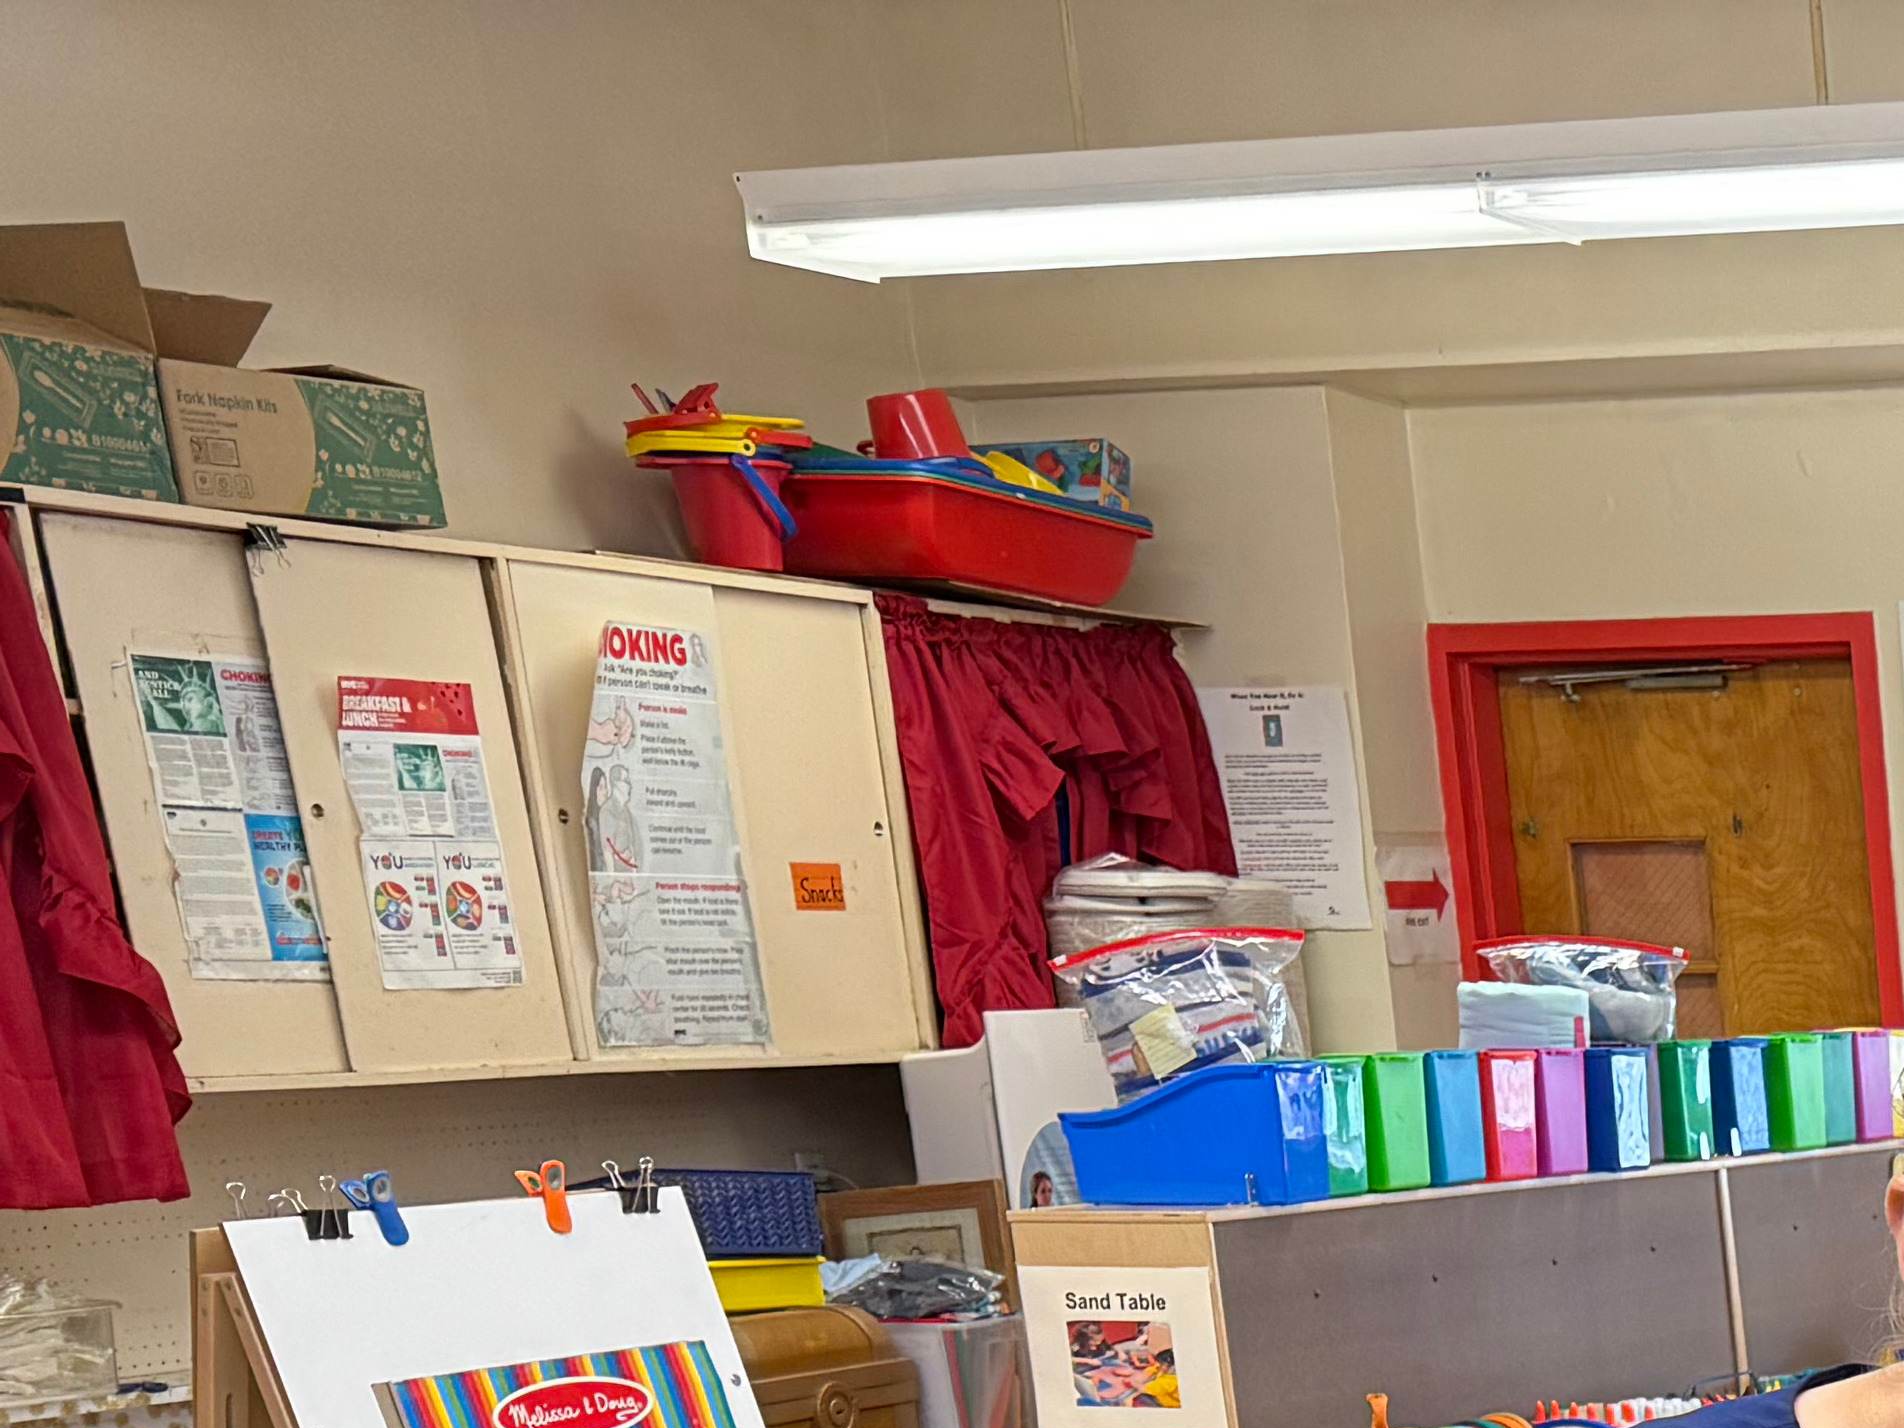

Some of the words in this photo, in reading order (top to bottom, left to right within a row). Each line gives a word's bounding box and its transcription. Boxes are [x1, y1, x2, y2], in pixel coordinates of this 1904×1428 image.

[799, 876, 845, 904] Snacks
[1065, 1292, 1111, 1310] Sand
[1116, 1292, 1166, 1311] Table
[594, 1392, 641, 1421] Doug
